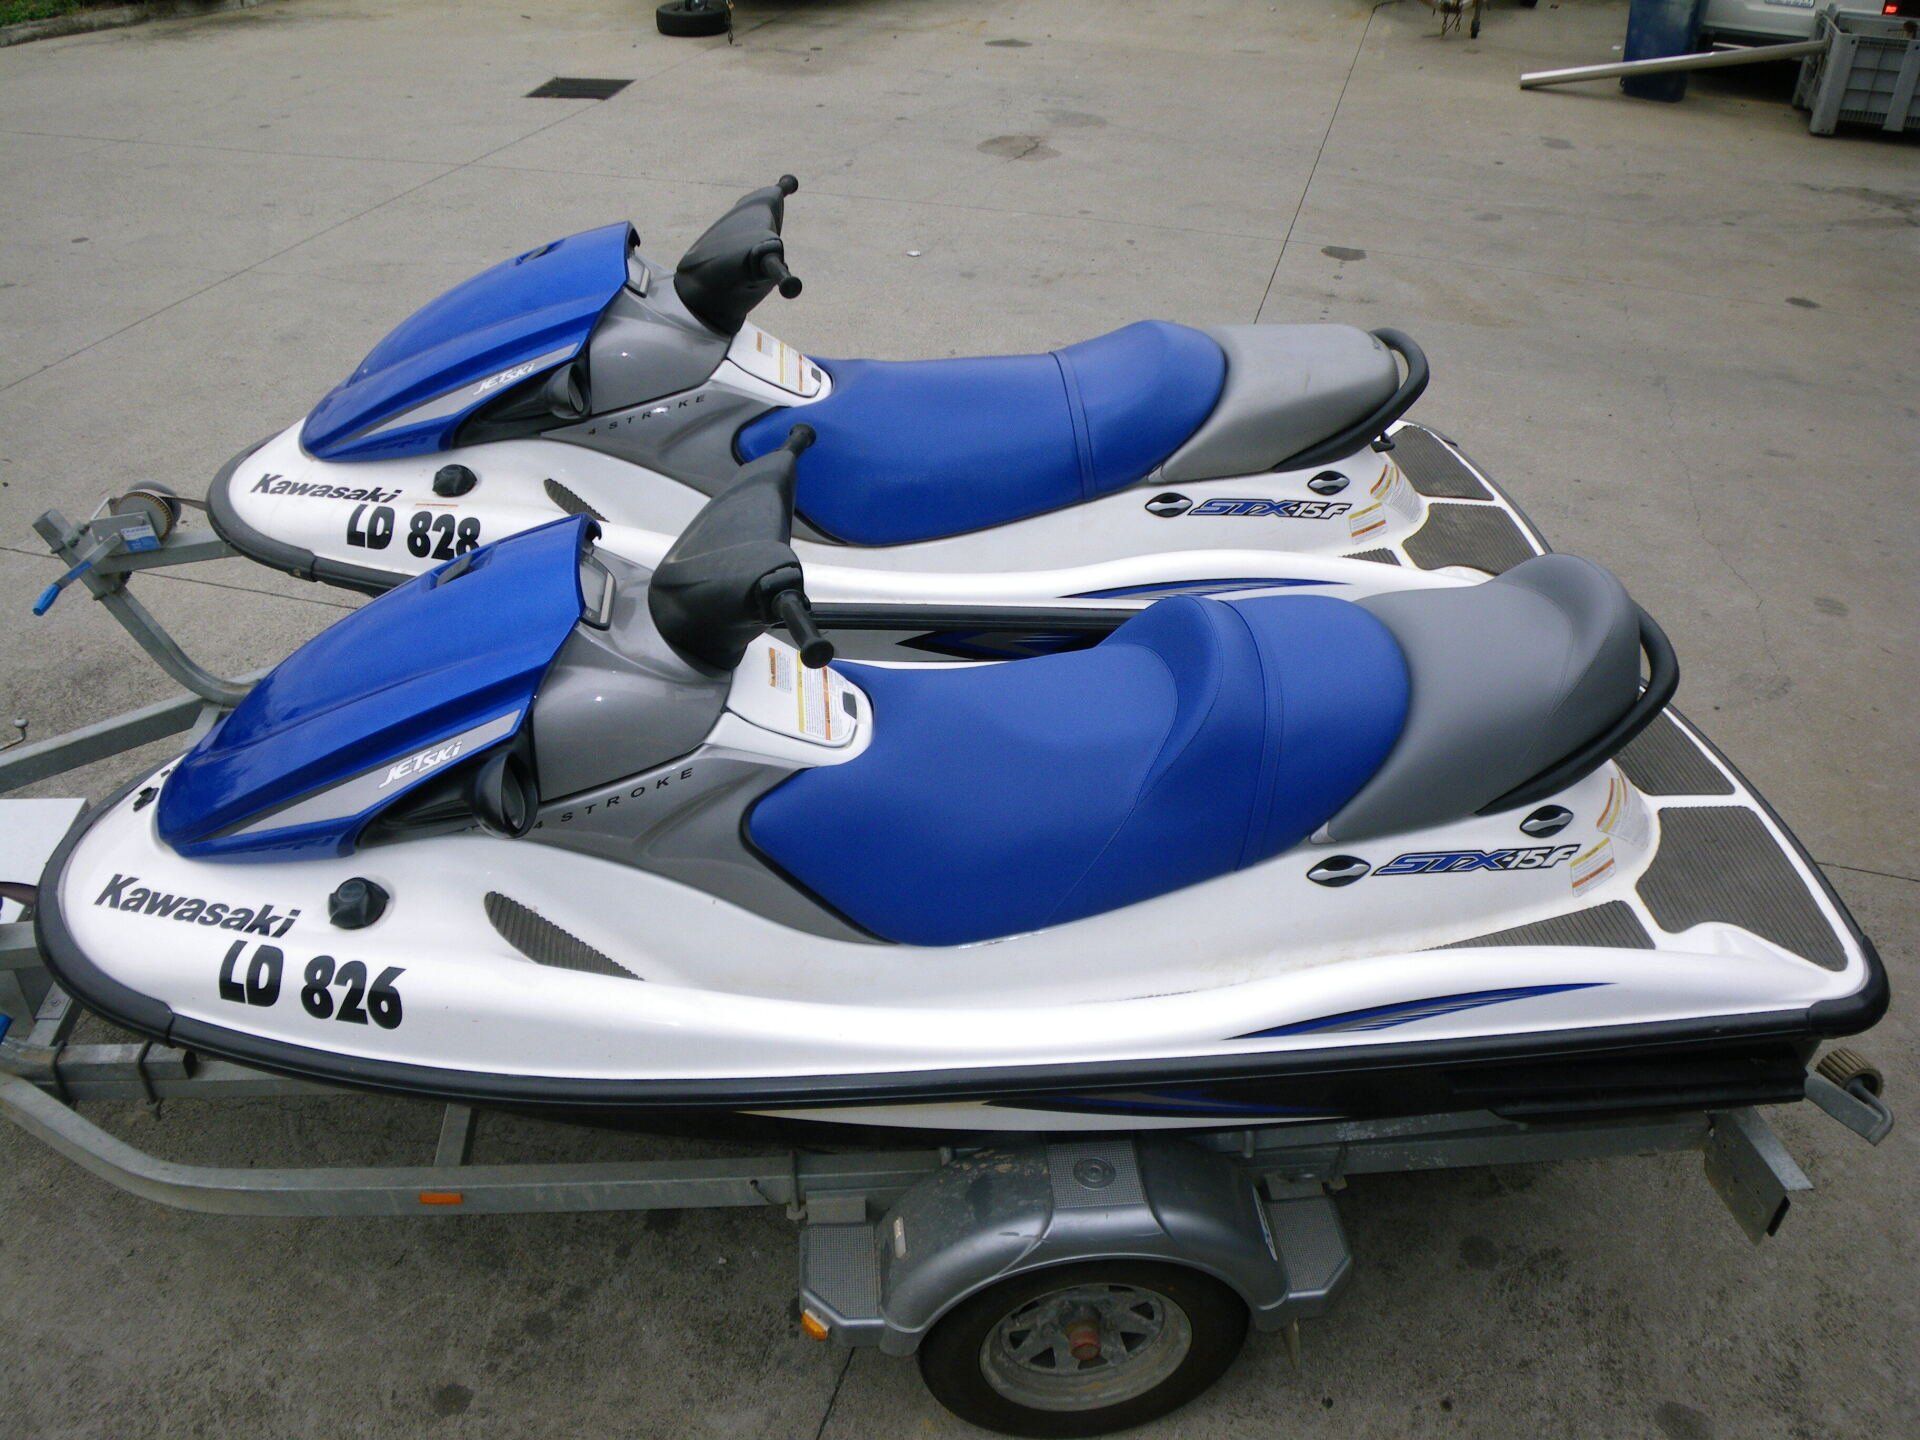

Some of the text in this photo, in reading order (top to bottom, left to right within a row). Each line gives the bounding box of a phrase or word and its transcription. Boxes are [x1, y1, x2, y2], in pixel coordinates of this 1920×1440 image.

[608, 394, 705, 430] STRKE
[251, 473, 403, 504] Kawasaki
[1188, 498, 1353, 520] STX-15F
[347, 503, 481, 561] LD 828
[560, 767, 694, 823] STROKE
[1370, 843, 1582, 876] STX-15F
[94, 873, 301, 938] Kawasaki
[219, 940, 407, 1030] LD 826
